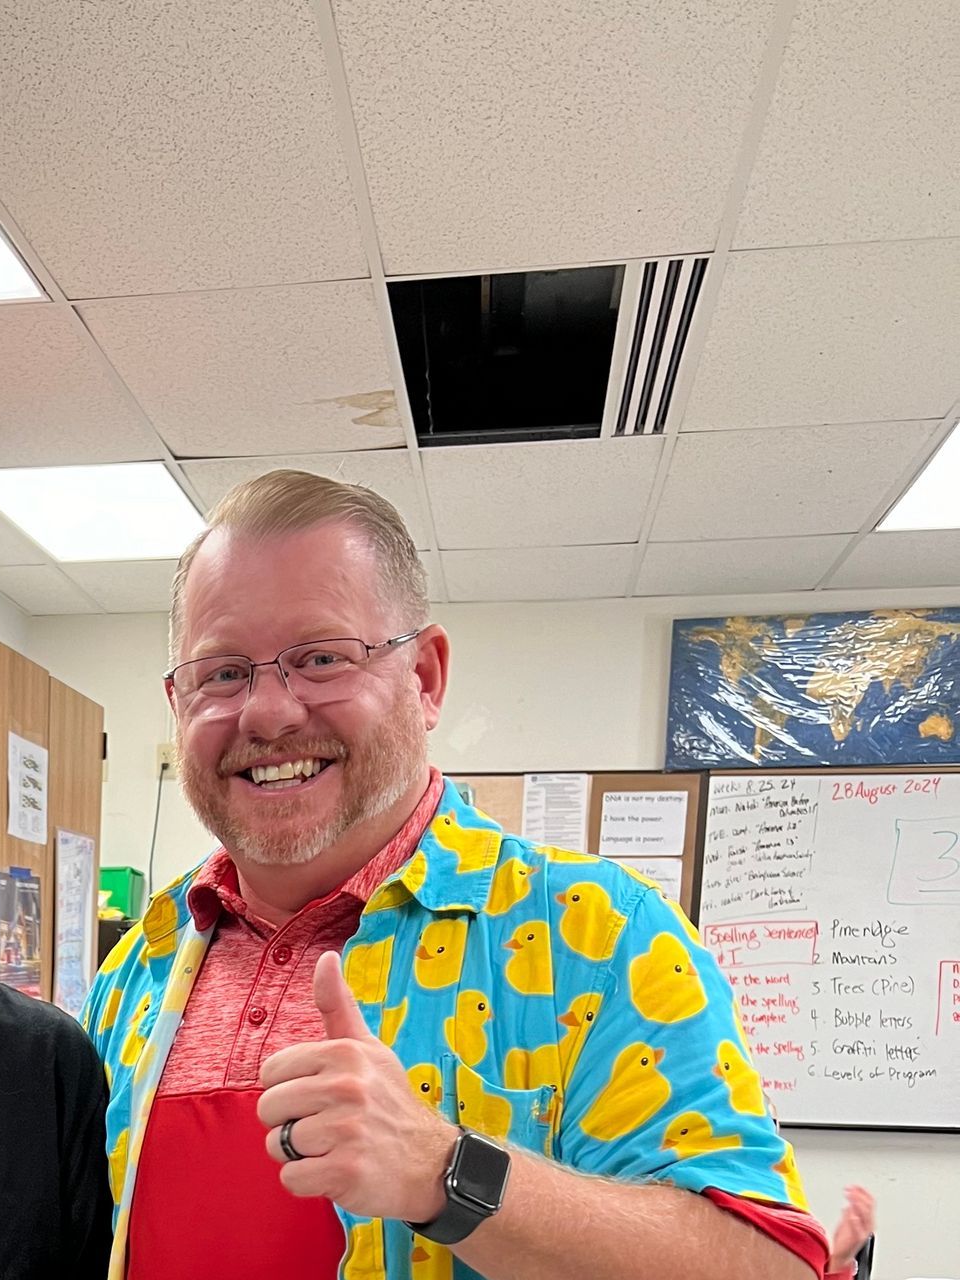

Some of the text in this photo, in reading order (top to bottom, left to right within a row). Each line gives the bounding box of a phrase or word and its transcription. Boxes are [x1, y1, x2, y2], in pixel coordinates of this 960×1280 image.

[855, 781, 898, 805] August
[903, 776, 942, 800] 2024
[604, 794, 622, 802] DNA
[645, 796, 655, 804] my
[602, 836, 633, 844] Language
[710, 926, 761, 950] Spelling
[743, 974, 762, 986] the
[765, 973, 791, 986] word
[830, 976, 865, 996] Trees
[871, 975, 916, 997] (Pine)
[741, 993, 758, 1007] the
[834, 1007, 872, 1028] Bubble
[755, 1042, 770, 1054] the
[824, 1065, 864, 1082] Levels
